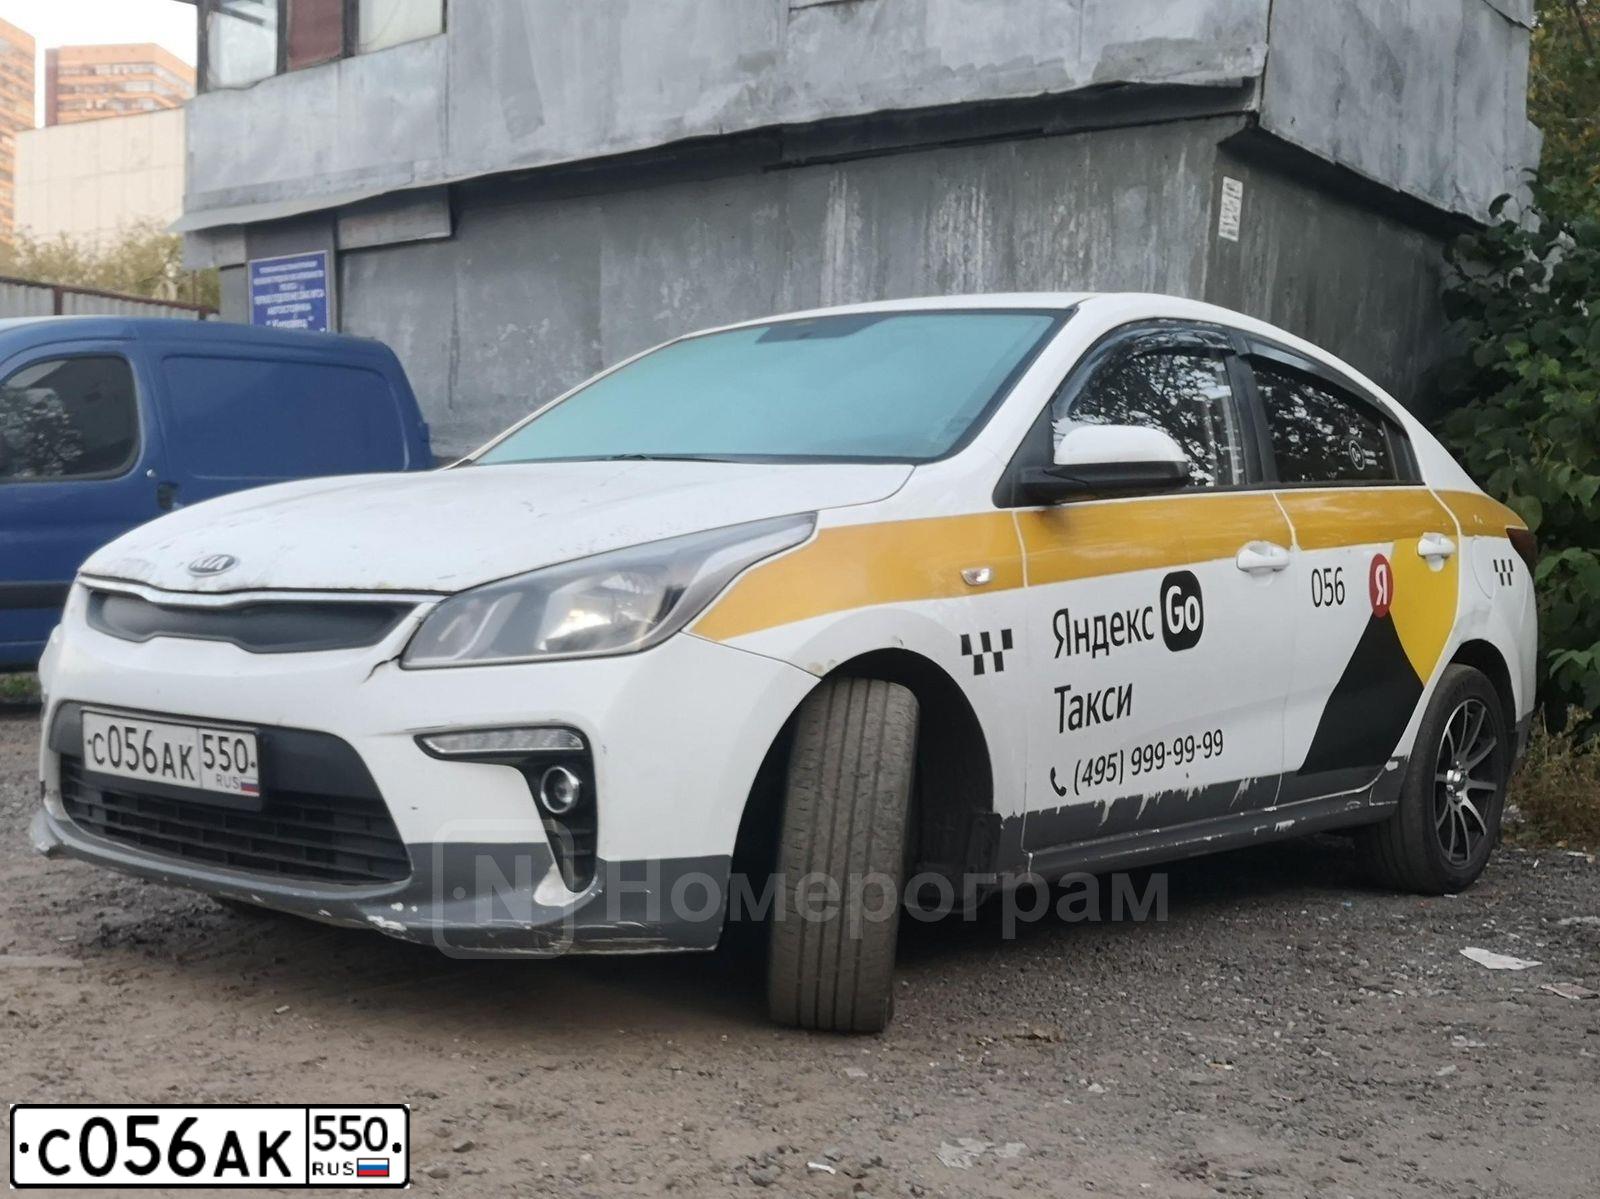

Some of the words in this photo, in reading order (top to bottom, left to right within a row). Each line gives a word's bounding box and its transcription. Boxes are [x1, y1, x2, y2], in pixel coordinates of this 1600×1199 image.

[1311, 566, 1346, 608] 056
[1375, 563, 1388, 606] Я
[1052, 606, 1155, 660] Яндекс
[1165, 585, 1201, 635] Go
[1054, 682, 1133, 735] Такси
[202, 733, 249, 774] 550
[1073, 749, 1124, 796] (495)
[1130, 728, 1225, 777] 999-99-99
[215, 773, 241, 790] RUS
